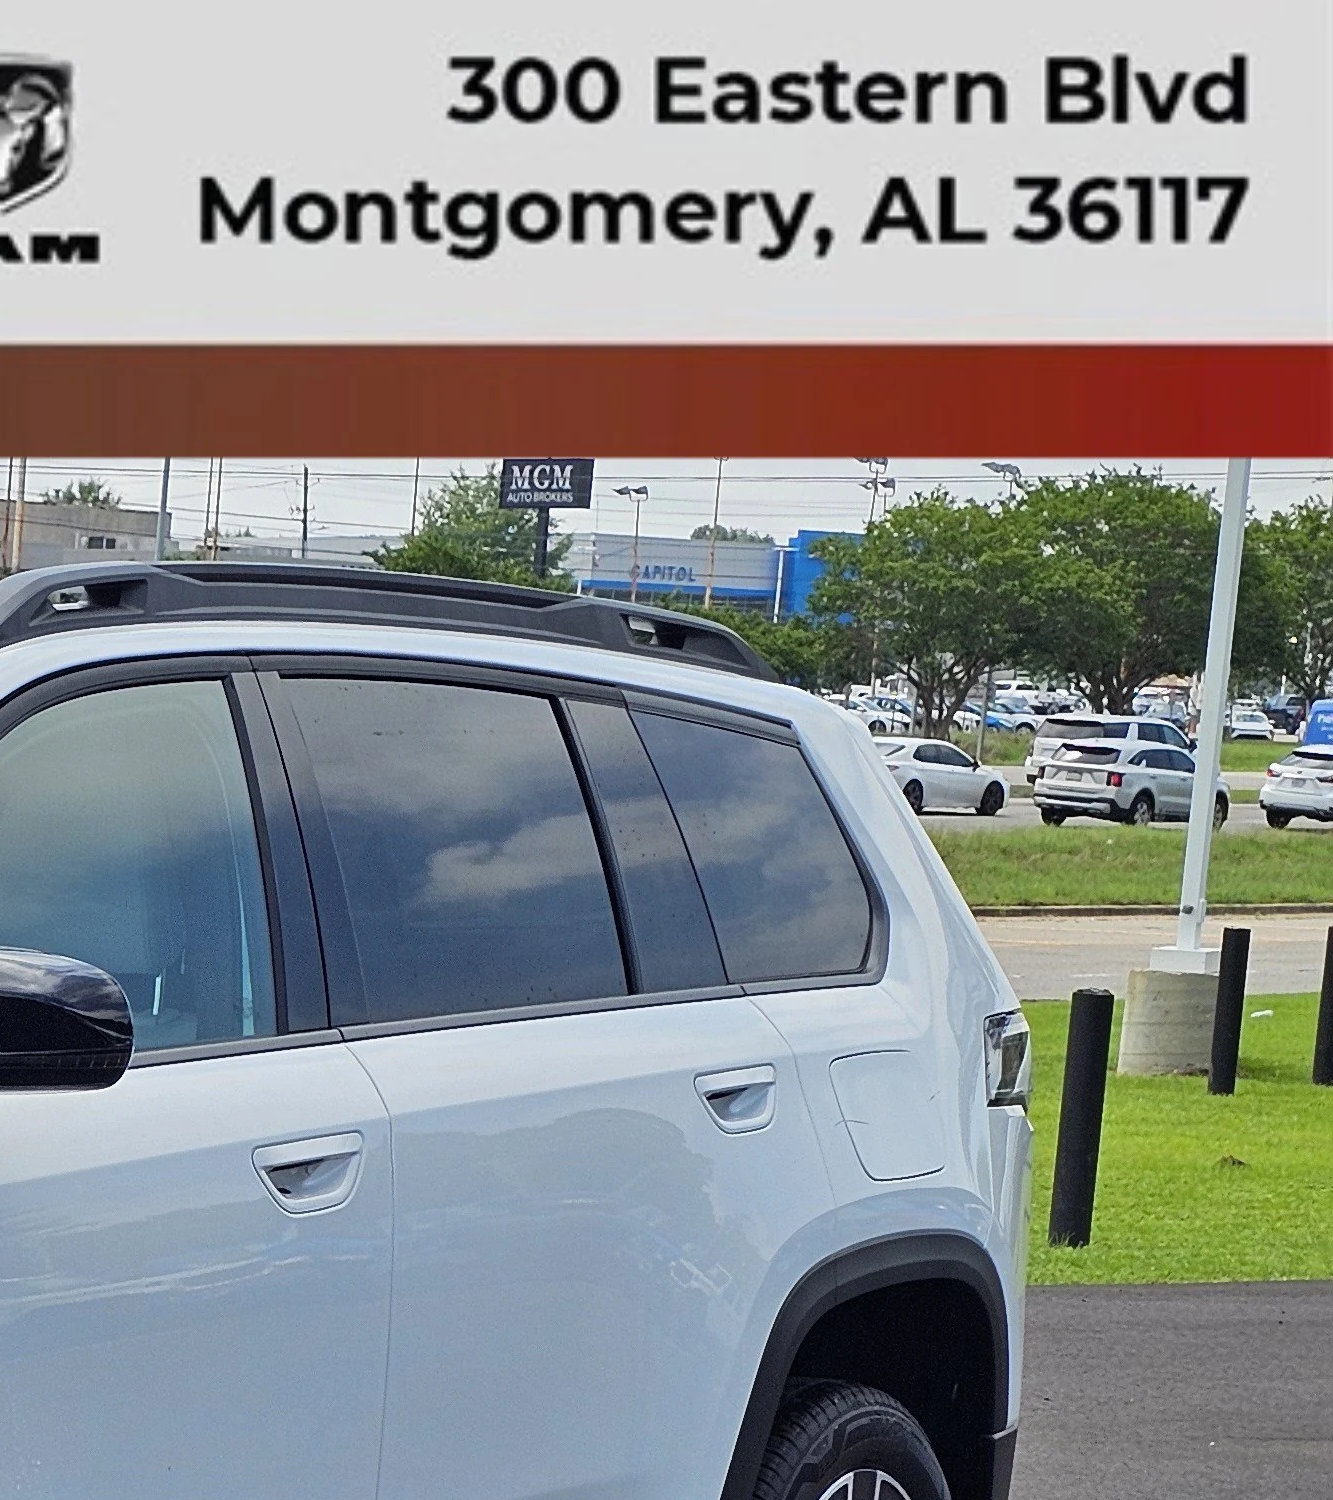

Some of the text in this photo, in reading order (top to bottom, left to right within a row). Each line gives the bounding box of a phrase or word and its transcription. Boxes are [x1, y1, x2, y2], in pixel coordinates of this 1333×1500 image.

[510, 464, 573, 490] MGM
[506, 491, 573, 503] AUTO BROKERS
